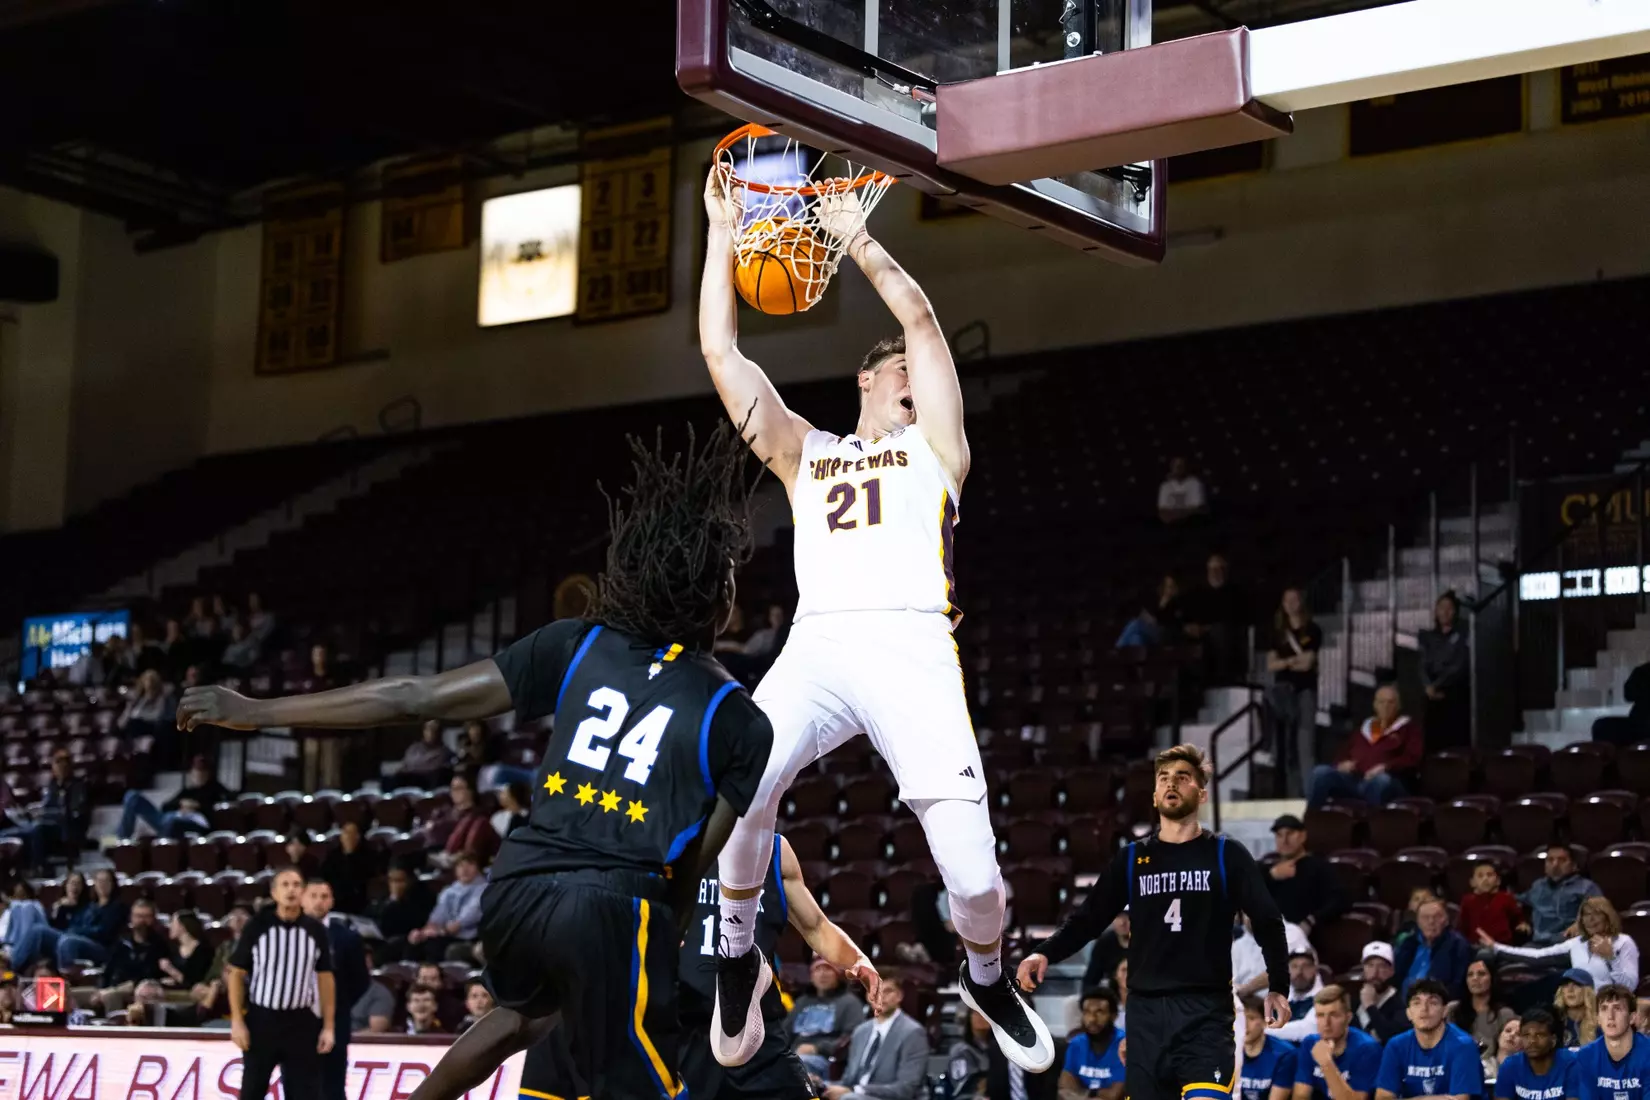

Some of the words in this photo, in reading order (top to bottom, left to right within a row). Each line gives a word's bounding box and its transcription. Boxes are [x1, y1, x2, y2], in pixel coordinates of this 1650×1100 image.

[826, 477, 882, 533] 21
[567, 686, 674, 786] 24
[1139, 871, 1177, 897] NORTH
[1179, 870, 1212, 892] PARK
[1163, 898, 1182, 932] 4
